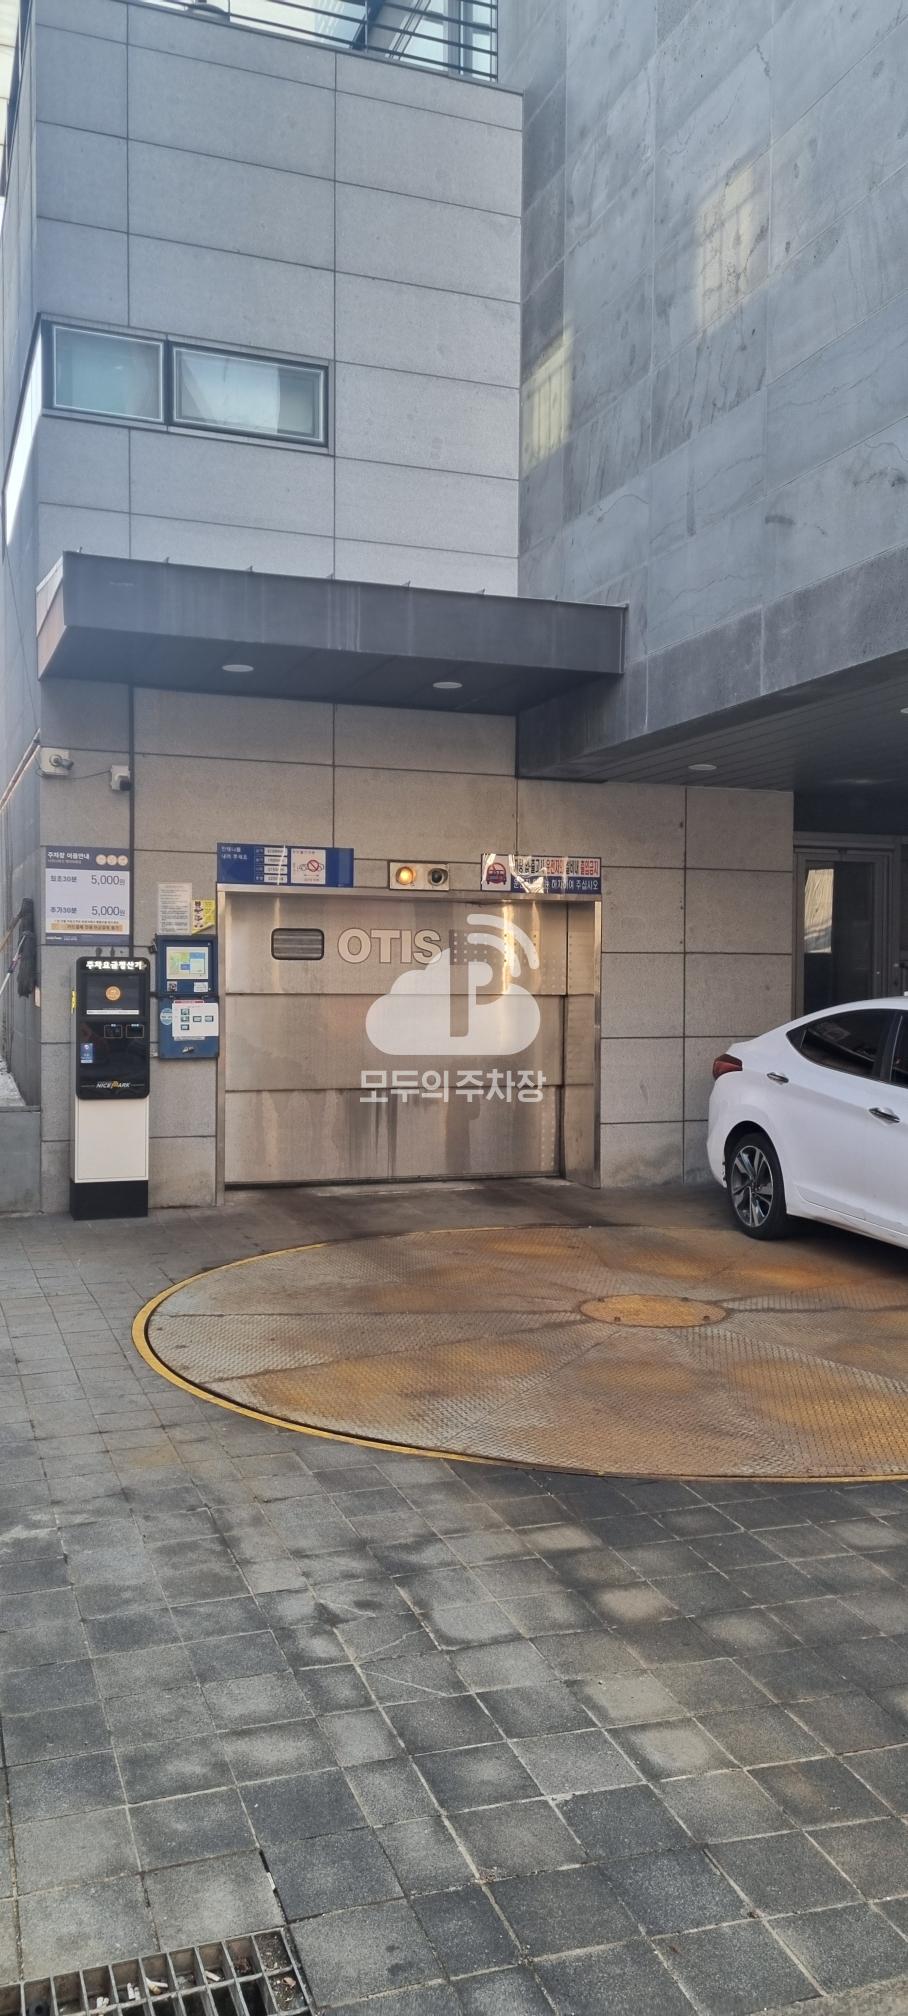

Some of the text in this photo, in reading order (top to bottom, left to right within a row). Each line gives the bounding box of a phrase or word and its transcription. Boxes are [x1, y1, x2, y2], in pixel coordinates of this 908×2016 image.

[47, 851, 90, 860] 주차장 이용안내
[580, 860, 599, 876] 출입금지
[91, 875, 126, 886] 5,000원
[576, 879, 599, 891] 주십시오
[50, 905, 126, 917] 추가30분 5,000원
[337, 927, 442, 964] OTIS
[86, 960, 144, 970] 주차요금정산기
